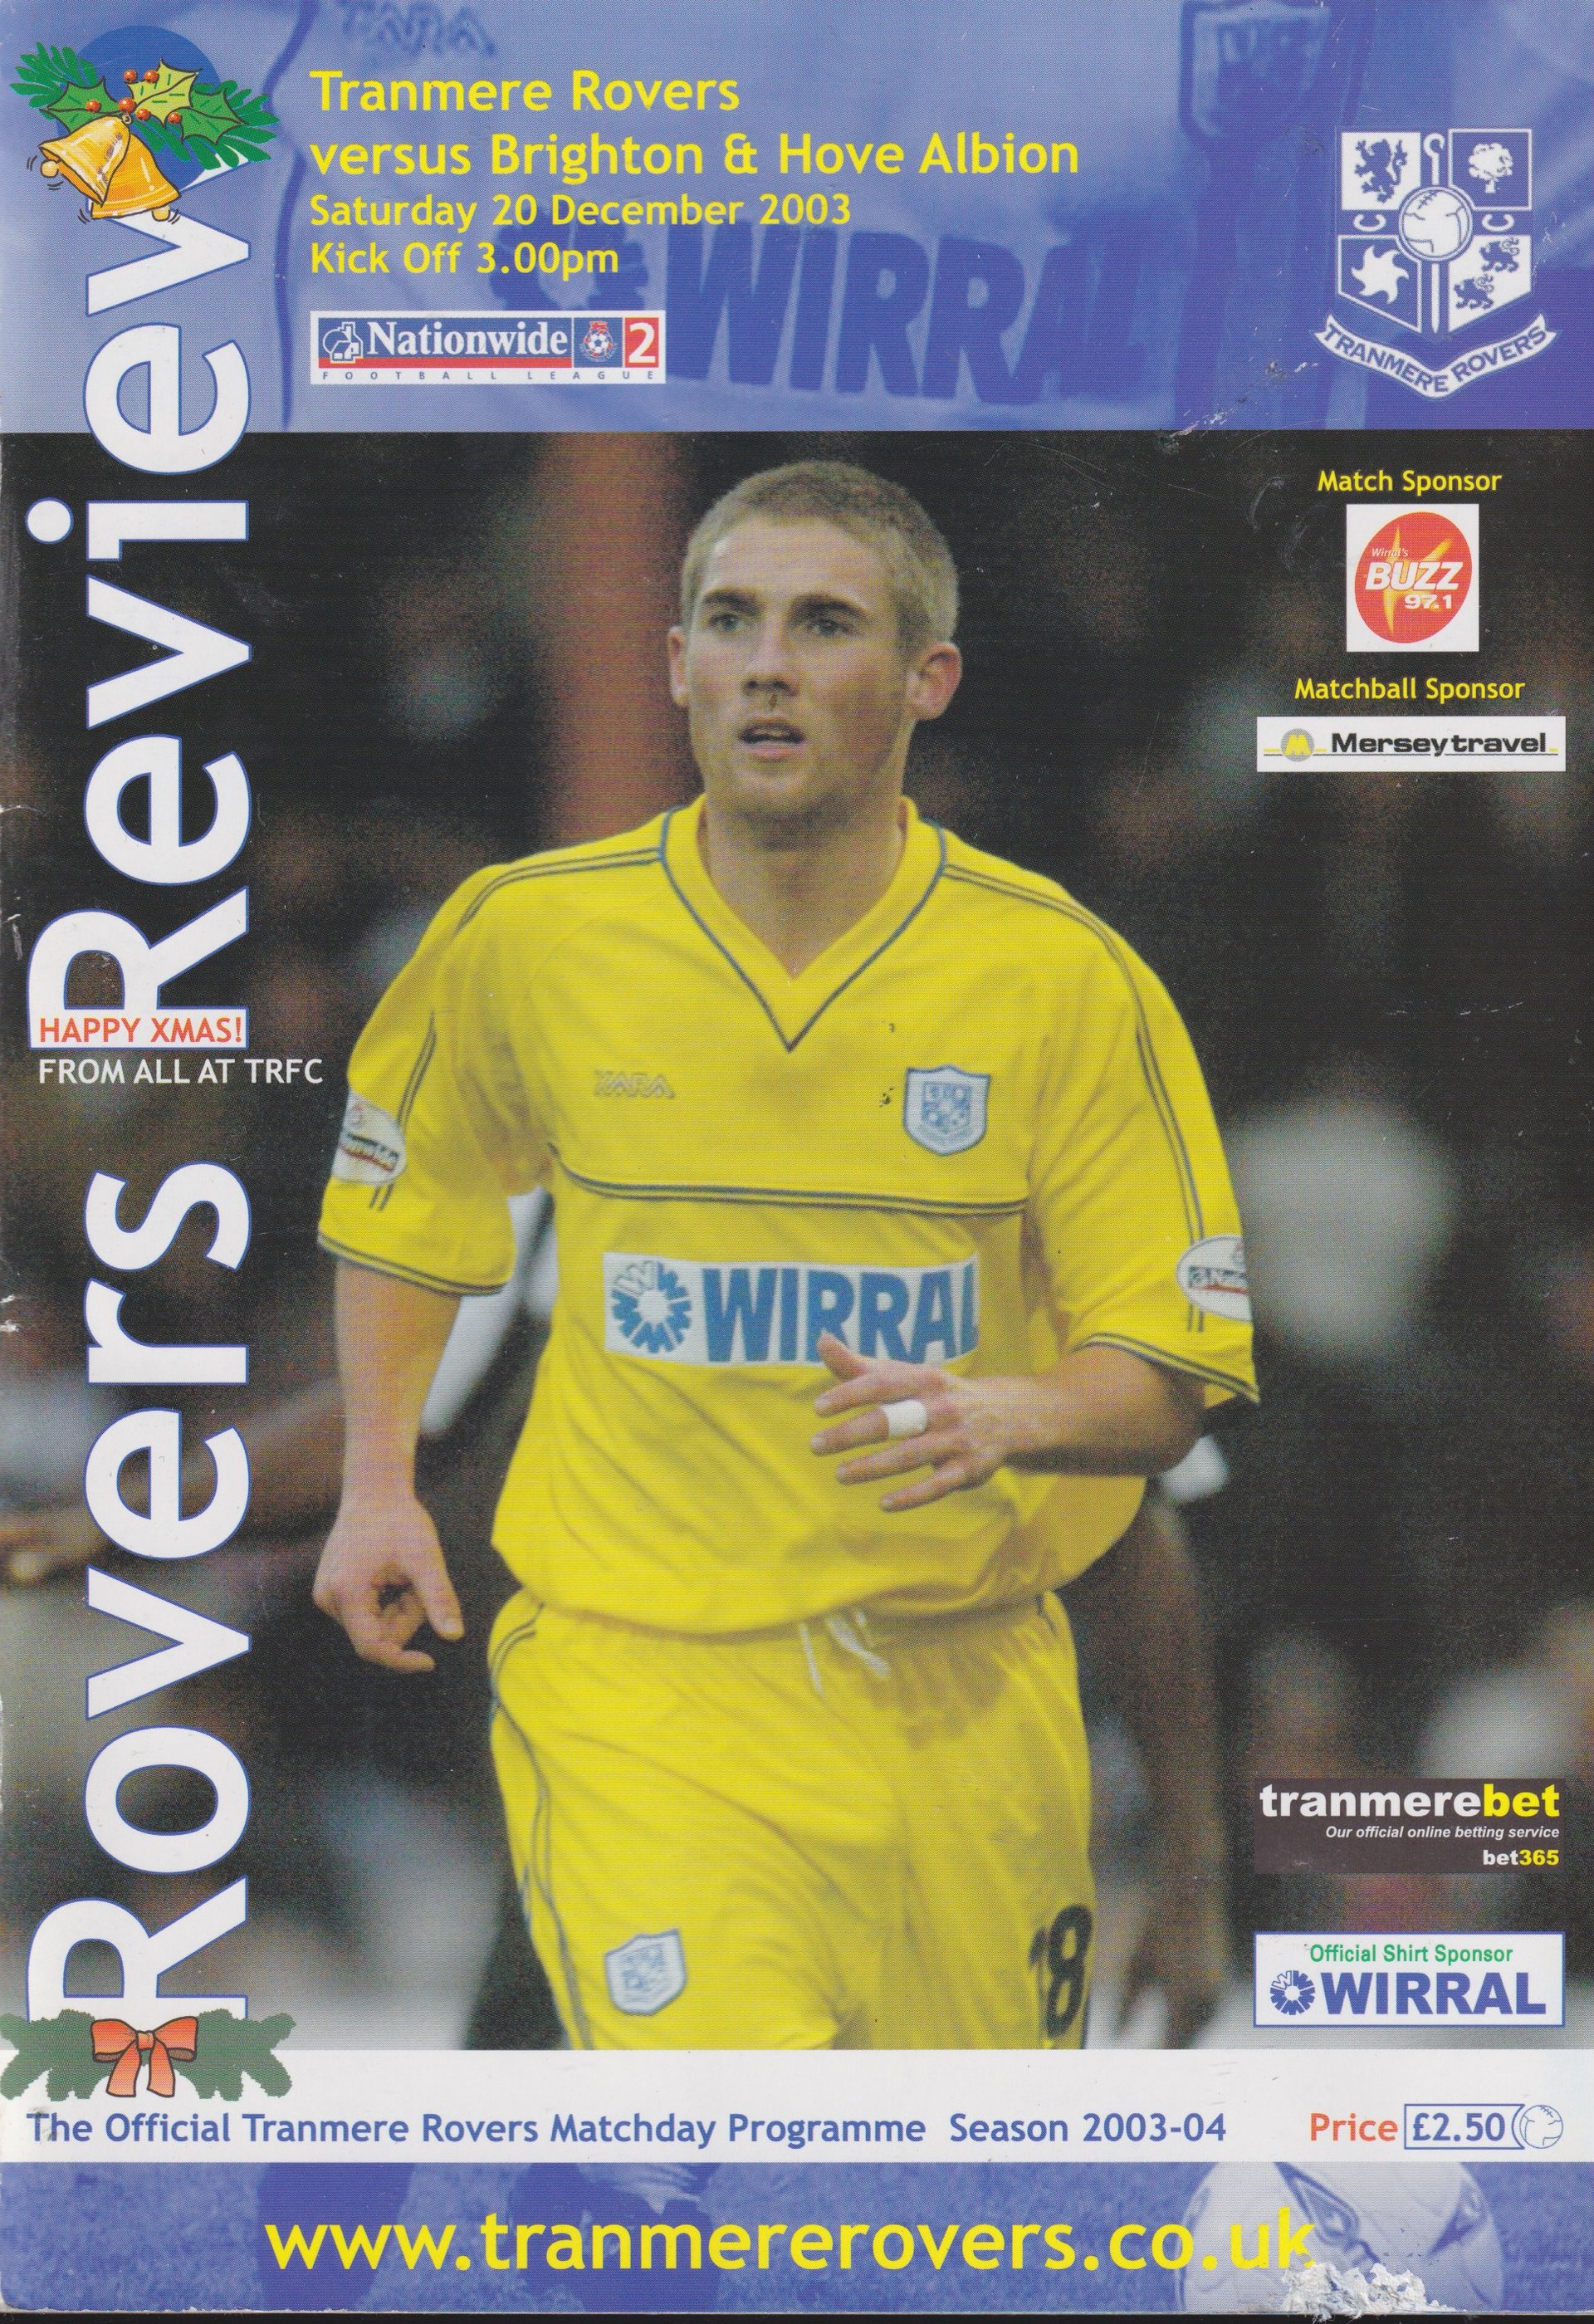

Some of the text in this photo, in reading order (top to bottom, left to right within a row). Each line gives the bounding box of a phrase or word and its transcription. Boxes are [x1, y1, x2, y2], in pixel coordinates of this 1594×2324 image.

[310, 70, 740, 111] Tranmere Rovers
[310, 130, 1078, 185] versus Brighton & Hove Albion
[310, 193, 851, 232] Saturday 20 December 2003
[311, 241, 619, 281] Kick Off 3.00pm
[366, 320, 569, 355] Nationwide
[628, 322, 656, 363] 2
[1324, 324, 1548, 394] TRANMERE ROVERS
[322, 370, 654, 381] FOOTBALL LEAGUE
[1318, 469, 1503, 497] Match Sponsor
[1371, 547, 1409, 559] Wirral's
[1365, 560, 1464, 590] BUZZ
[1404, 594, 1452, 609] 97.1
[1294, 677, 1527, 705] Matchball Sponsor
[1332, 731, 1547, 757] Merseytravel
[40, 1016, 242, 1043] HAPPY XMAS!
[39, 1058, 324, 1084] FROM ALL AT TRFC
[27, 1161, 251, 2023] Rovers
[1259, 1783, 1561, 1818] tranmerebet
[1326, 1825, 1560, 1841] Our official online betting service
[1483, 1849, 1560, 1867] bet365
[1309, 1944, 1513, 1967] Official Shirt Sponsor
[1320, 1971, 1547, 2016] WIRRAL
[26, 2111, 1226, 2150] The Official Tranmere Rovers Matchday Programme Season 2003-04
[1310, 2111, 1505, 2143] Price £2.50
[265, 2205, 1315, 2272] www.tranmererovers.co.uk
